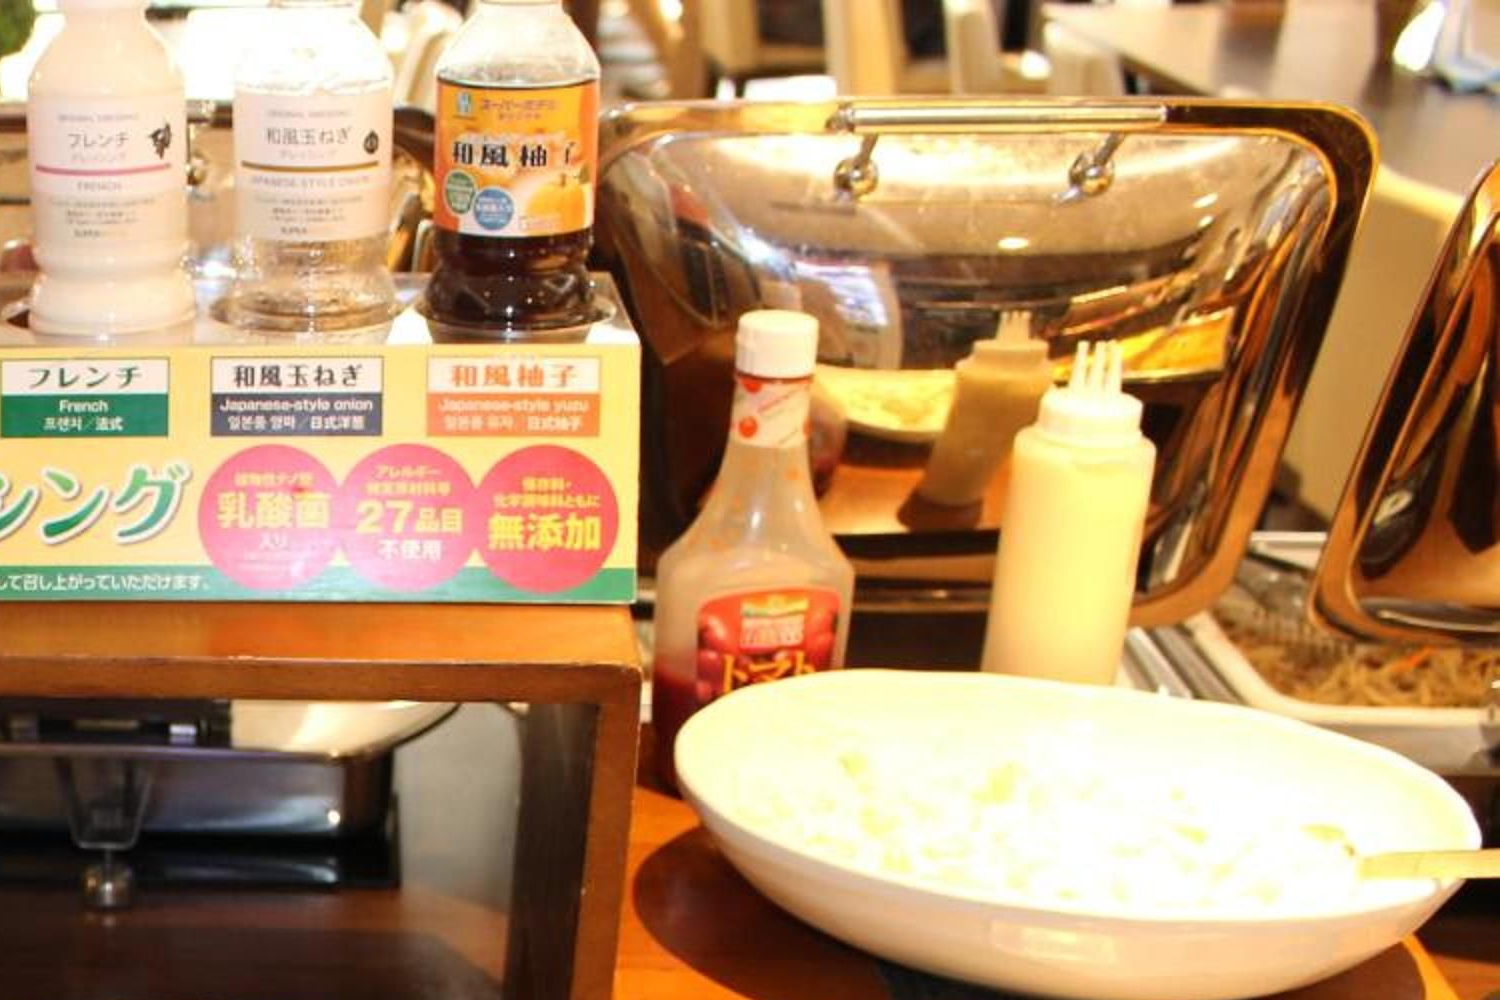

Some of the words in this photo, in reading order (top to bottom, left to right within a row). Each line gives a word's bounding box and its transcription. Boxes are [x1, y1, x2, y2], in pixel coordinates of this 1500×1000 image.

[67, 131, 130, 148] フレンチ
[266, 126, 353, 145] 和風玉ねぎ
[28, 365, 143, 389] フレンチ
[233, 363, 365, 388] 和風玉ねぎ
[450, 363, 579, 388] 和風柚子
[59, 399, 109, 413] French
[219, 398, 331, 413] Japanese-style
[334, 398, 374, 411] onion
[216, 491, 330, 529] 乳酸菌
[355, 499, 463, 535] 27品目
[488, 512, 602, 551] 無添加
[377, 539, 442, 561] 不使用
[723, 650, 817, 693] トマト
